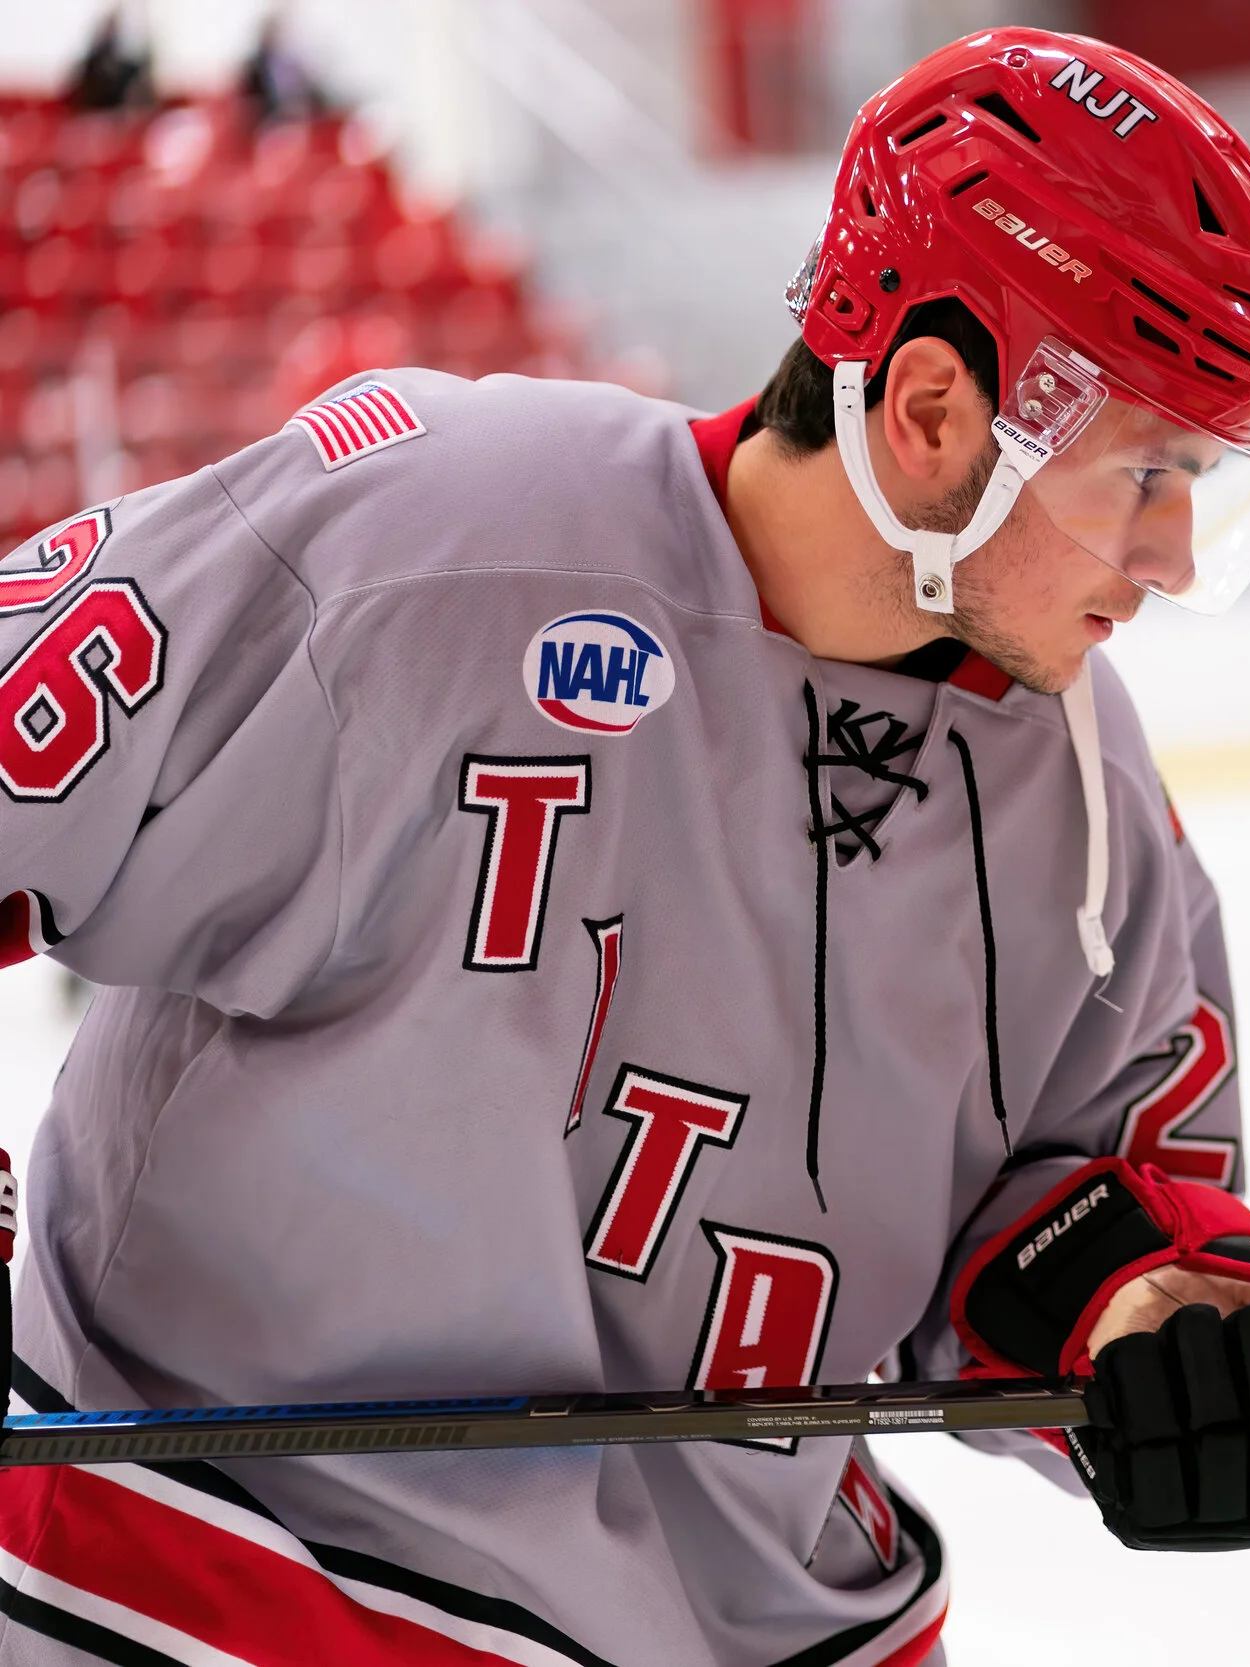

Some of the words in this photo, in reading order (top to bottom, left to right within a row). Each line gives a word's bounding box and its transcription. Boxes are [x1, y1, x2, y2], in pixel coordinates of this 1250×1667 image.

[1048, 58, 1159, 141] NJT
[972, 198, 1092, 284] BAUER
[994, 420, 1048, 458] BAUER
[537, 641, 651, 708] NAHL
[1016, 1183, 1109, 1271] BAUER
